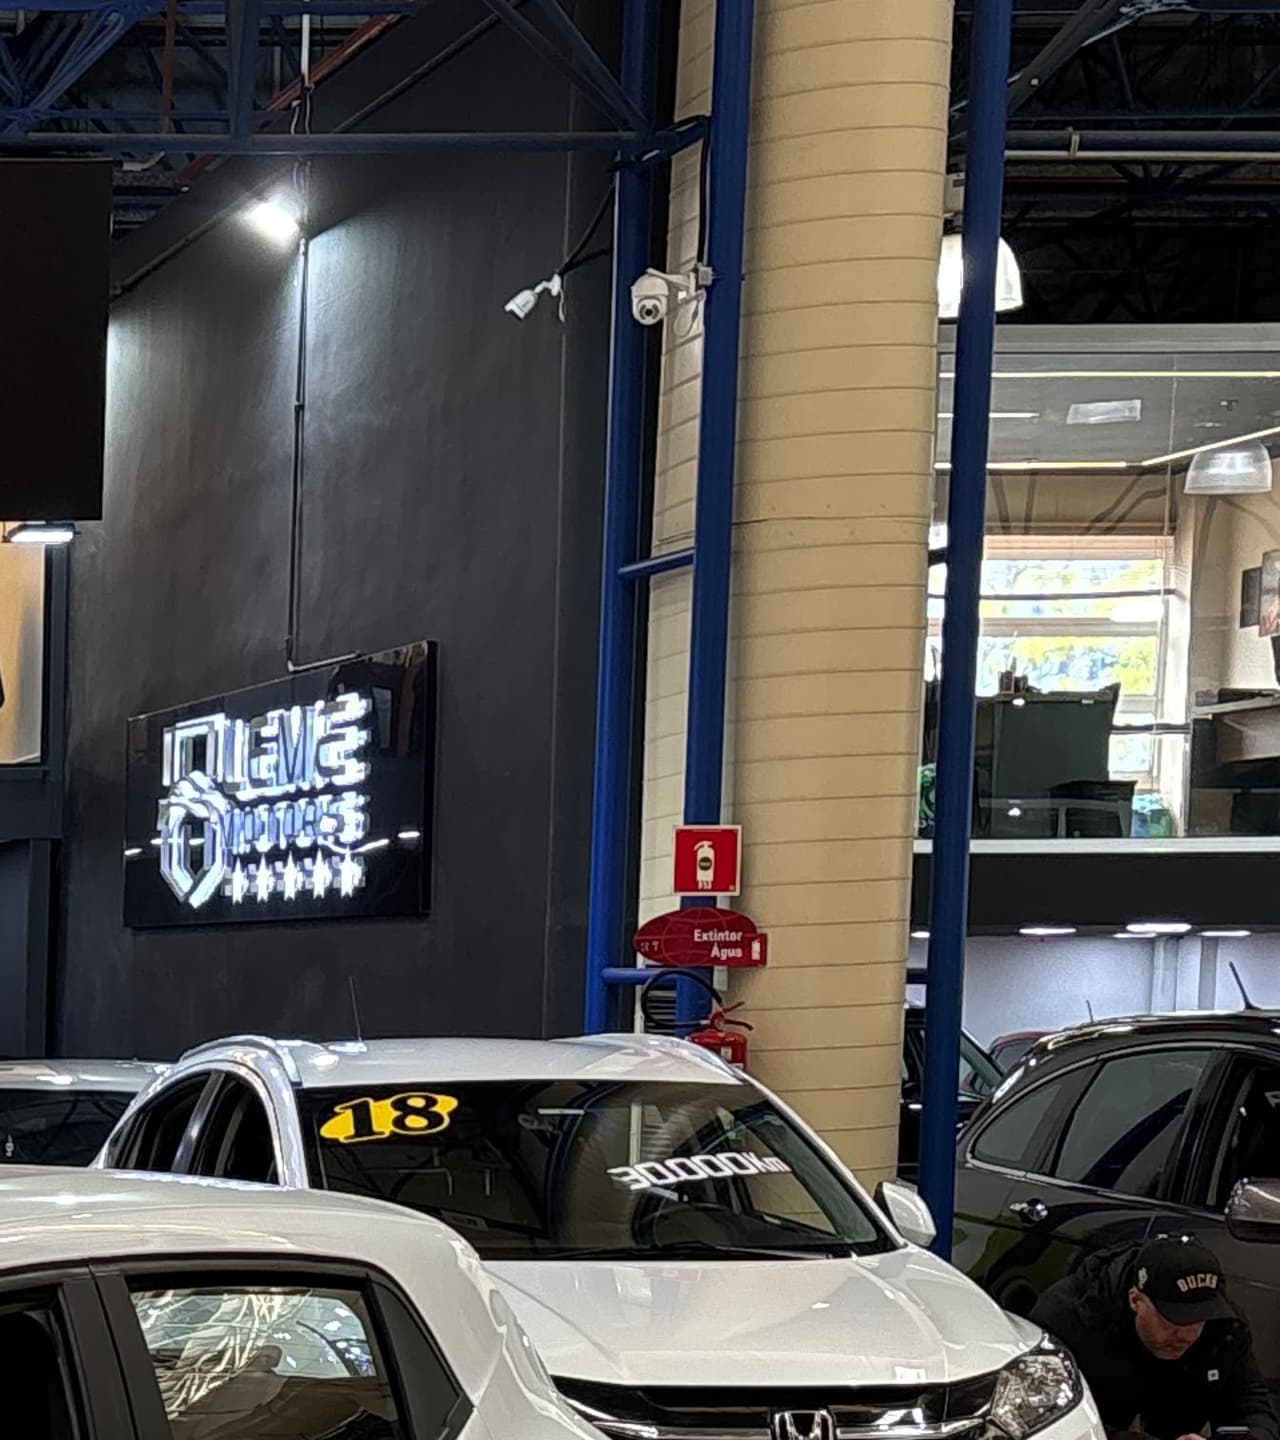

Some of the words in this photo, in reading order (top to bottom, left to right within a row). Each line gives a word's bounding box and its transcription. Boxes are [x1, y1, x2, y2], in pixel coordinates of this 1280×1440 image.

[693, 929, 743, 942] Extintor
[710, 942, 743, 960] Água
[332, 1092, 452, 1143] 18
